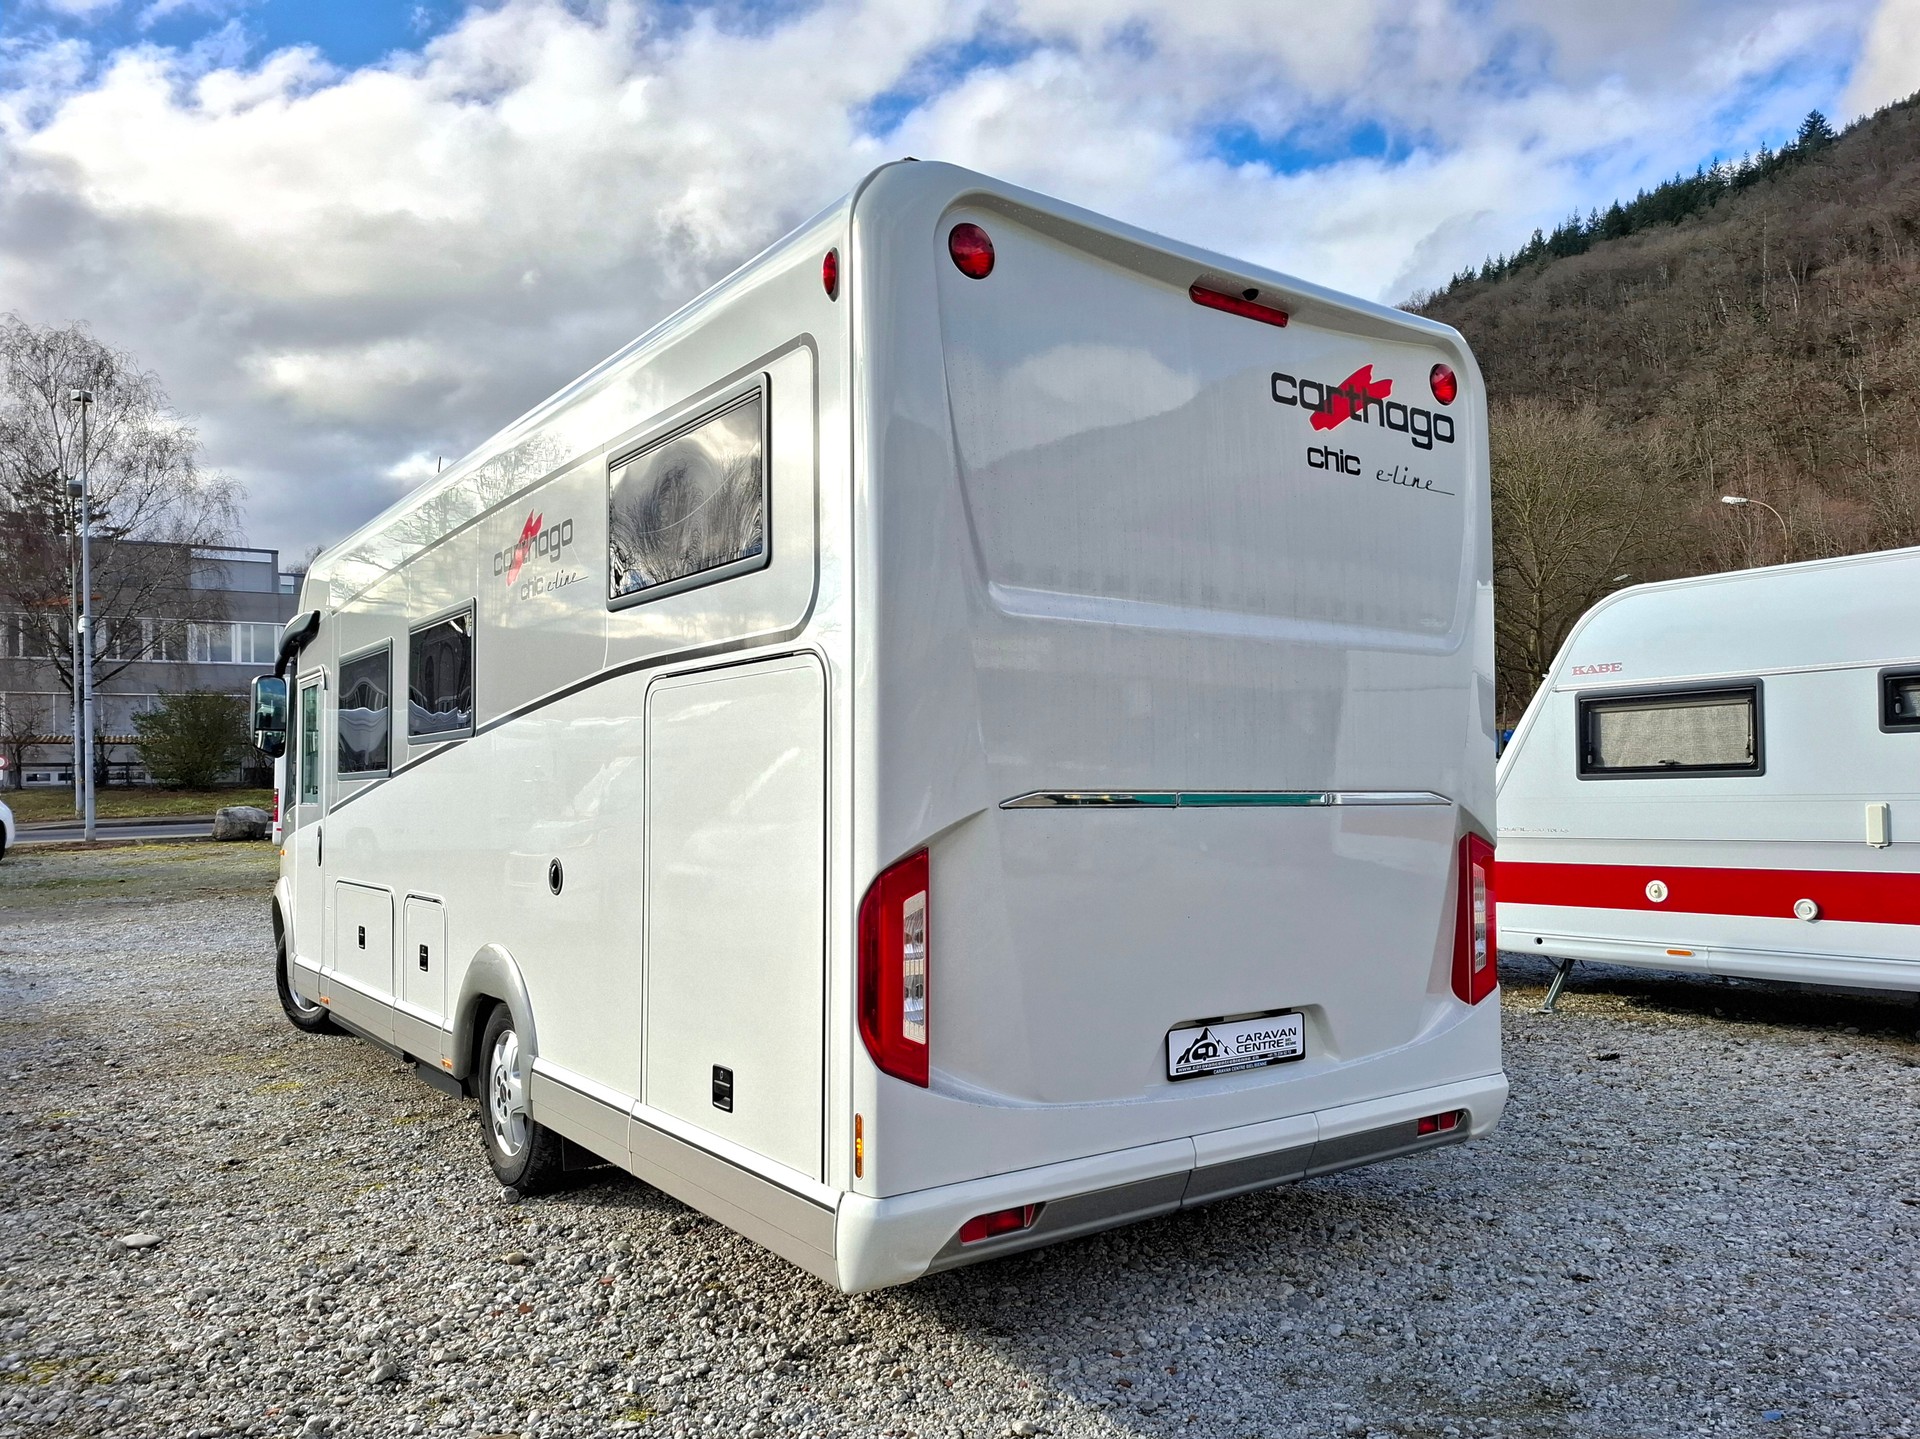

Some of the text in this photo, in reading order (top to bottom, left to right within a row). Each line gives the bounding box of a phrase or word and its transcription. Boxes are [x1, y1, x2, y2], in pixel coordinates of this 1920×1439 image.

[1271, 371, 1455, 450] carthago
[1307, 445, 1455, 496] chic e-line
[1572, 662, 1623, 676] KABE
[1236, 1027, 1297, 1044] CARAVAN
[1236, 1039, 1285, 1054] CENTRE
